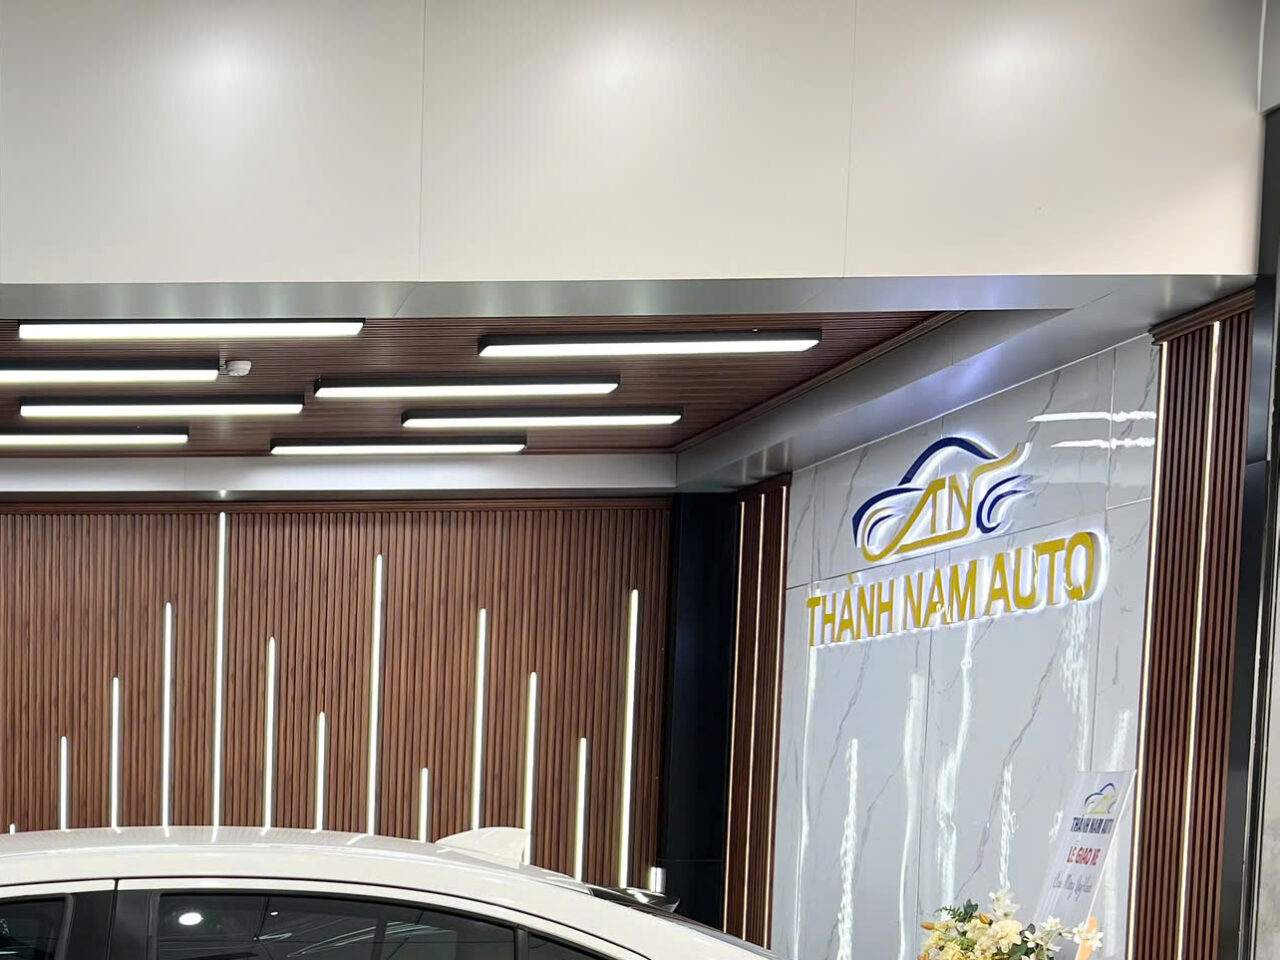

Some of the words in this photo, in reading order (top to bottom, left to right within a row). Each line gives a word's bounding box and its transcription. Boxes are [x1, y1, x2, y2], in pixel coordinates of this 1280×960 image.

[806, 572, 895, 647] THÀNH
[903, 560, 978, 632] NAM
[985, 531, 1097, 617] AUTO
